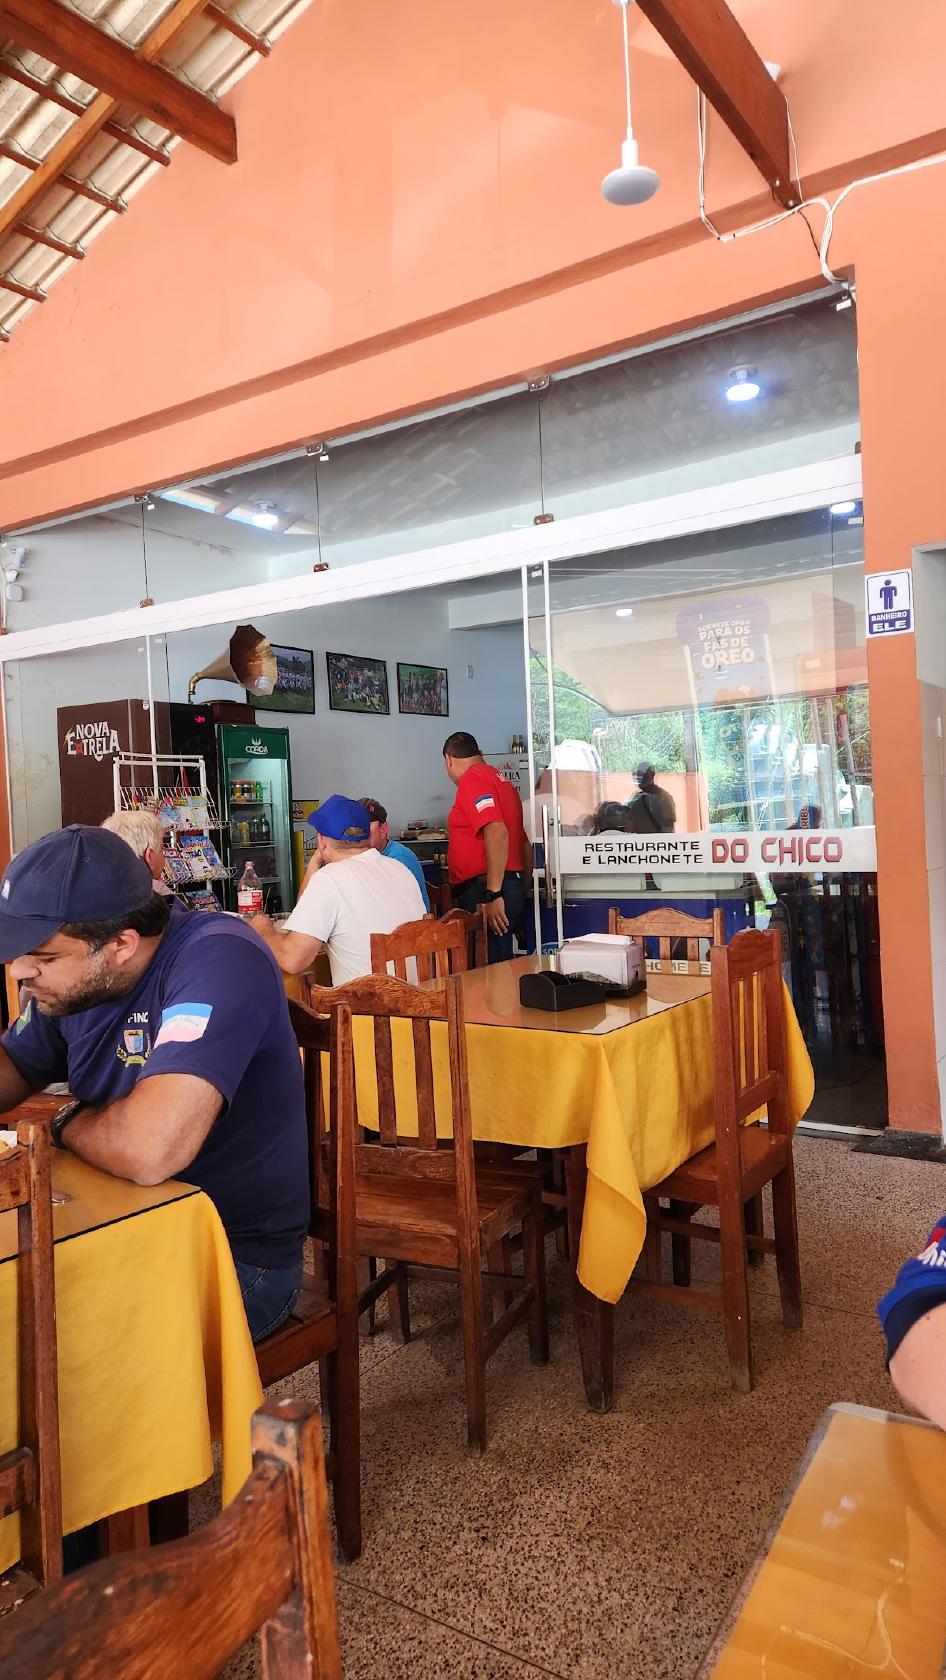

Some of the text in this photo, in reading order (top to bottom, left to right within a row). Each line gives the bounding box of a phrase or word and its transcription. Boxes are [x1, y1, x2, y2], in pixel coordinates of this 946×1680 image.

[871, 611, 907, 622] BANHEIRO
[697, 621, 730, 633] SORVETE
[872, 620, 907, 632] ELE
[699, 625, 751, 640] PARA OS
[730, 636, 749, 648] DE
[702, 647, 755, 669] OREO
[75, 721, 110, 740] NOVA
[585, 841, 700, 853] RESTAURANTE
[712, 836, 843, 866] DO CHICO
[582, 854, 704, 865] E LANCHONETE
